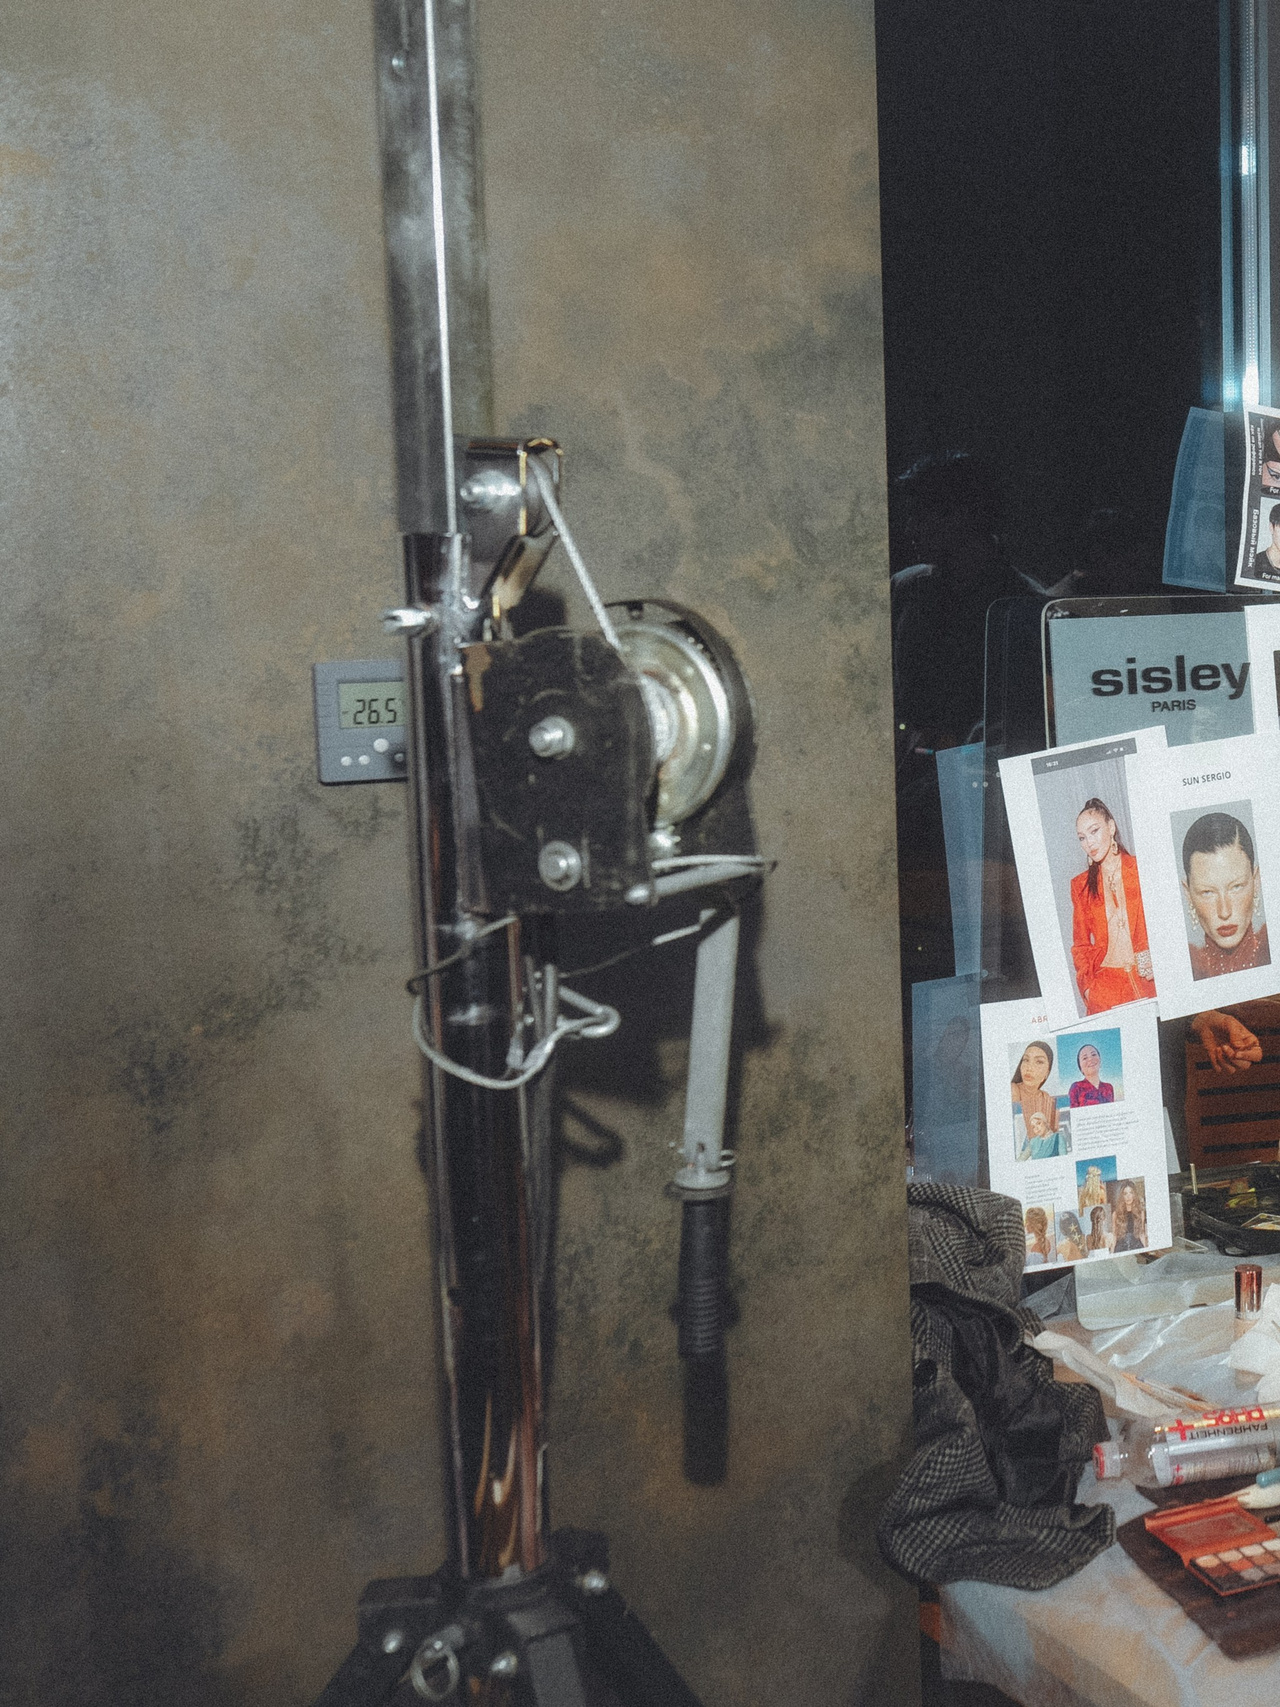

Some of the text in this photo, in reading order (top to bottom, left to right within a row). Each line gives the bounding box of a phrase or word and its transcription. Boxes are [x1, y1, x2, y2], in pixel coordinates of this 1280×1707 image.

[1269, 486, 1280, 494] For
[1248, 509, 1259, 567] Базовый мэйк
[1091, 655, 1251, 699] sisley
[1151, 699, 1197, 713] PARIS
[1182, 771, 1232, 787] SUN SERGIO
[1188, 1422, 1269, 1440] FAHRENHEIT
